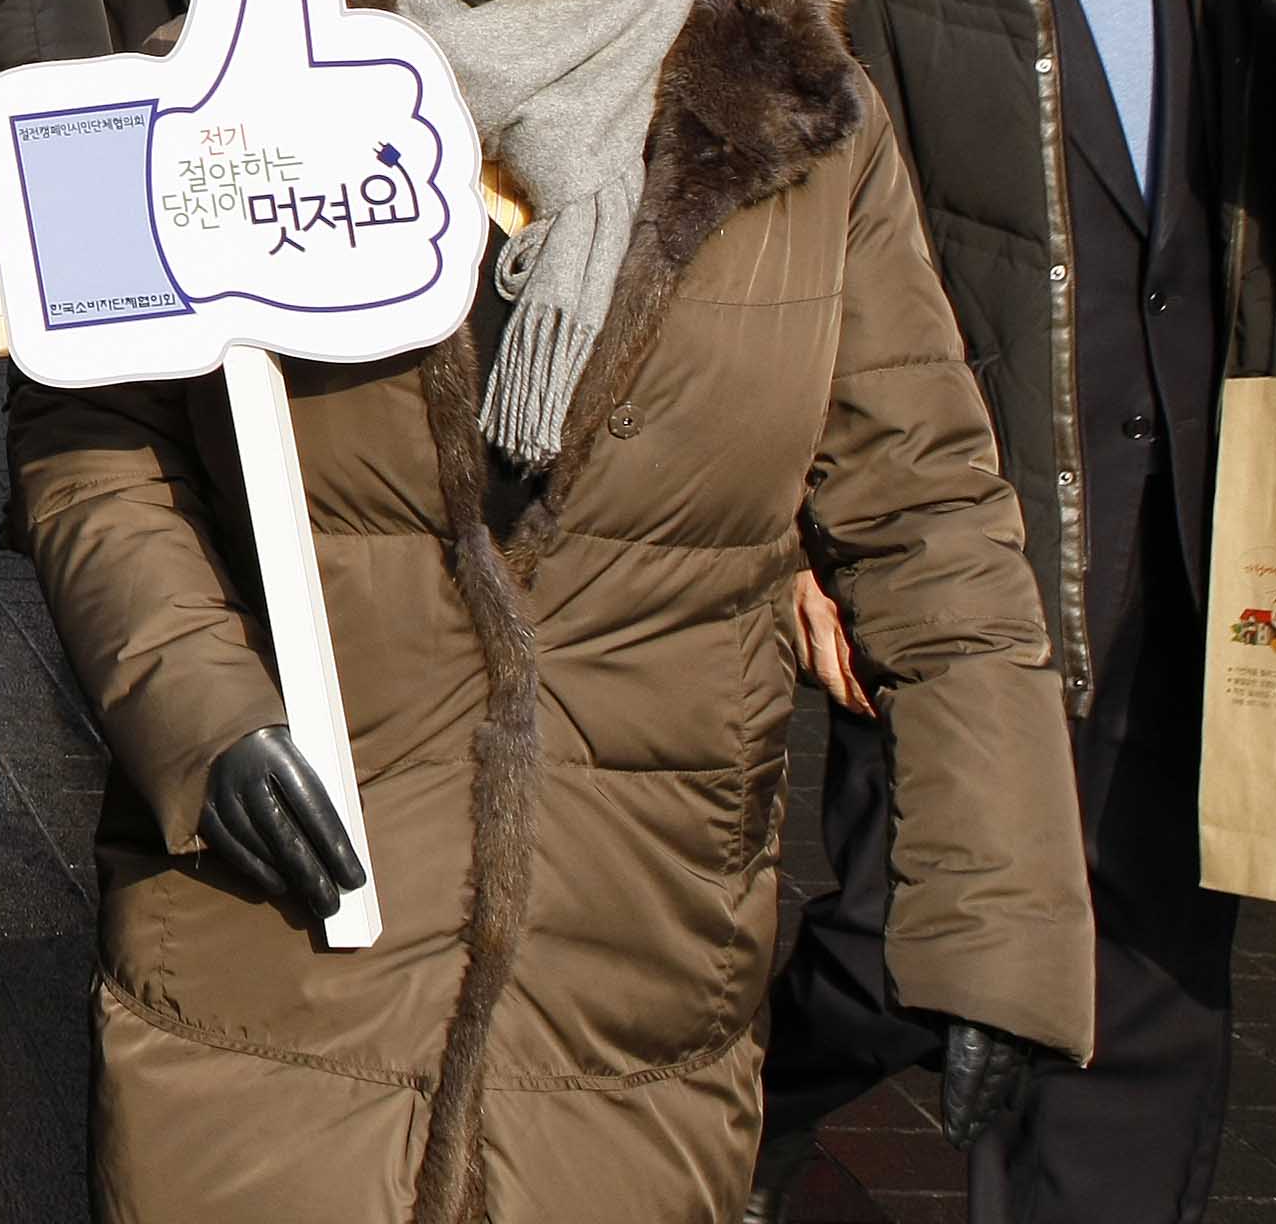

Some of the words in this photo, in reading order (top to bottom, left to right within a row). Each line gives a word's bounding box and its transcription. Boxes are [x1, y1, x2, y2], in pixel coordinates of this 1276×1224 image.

[199, 124, 249, 156] 전기
[178, 147, 304, 194] 절약하는
[162, 190, 249, 230] 당신이
[248, 174, 420, 255] 멋져요
[50, 293, 176, 317] 한국소비자단체협의회
